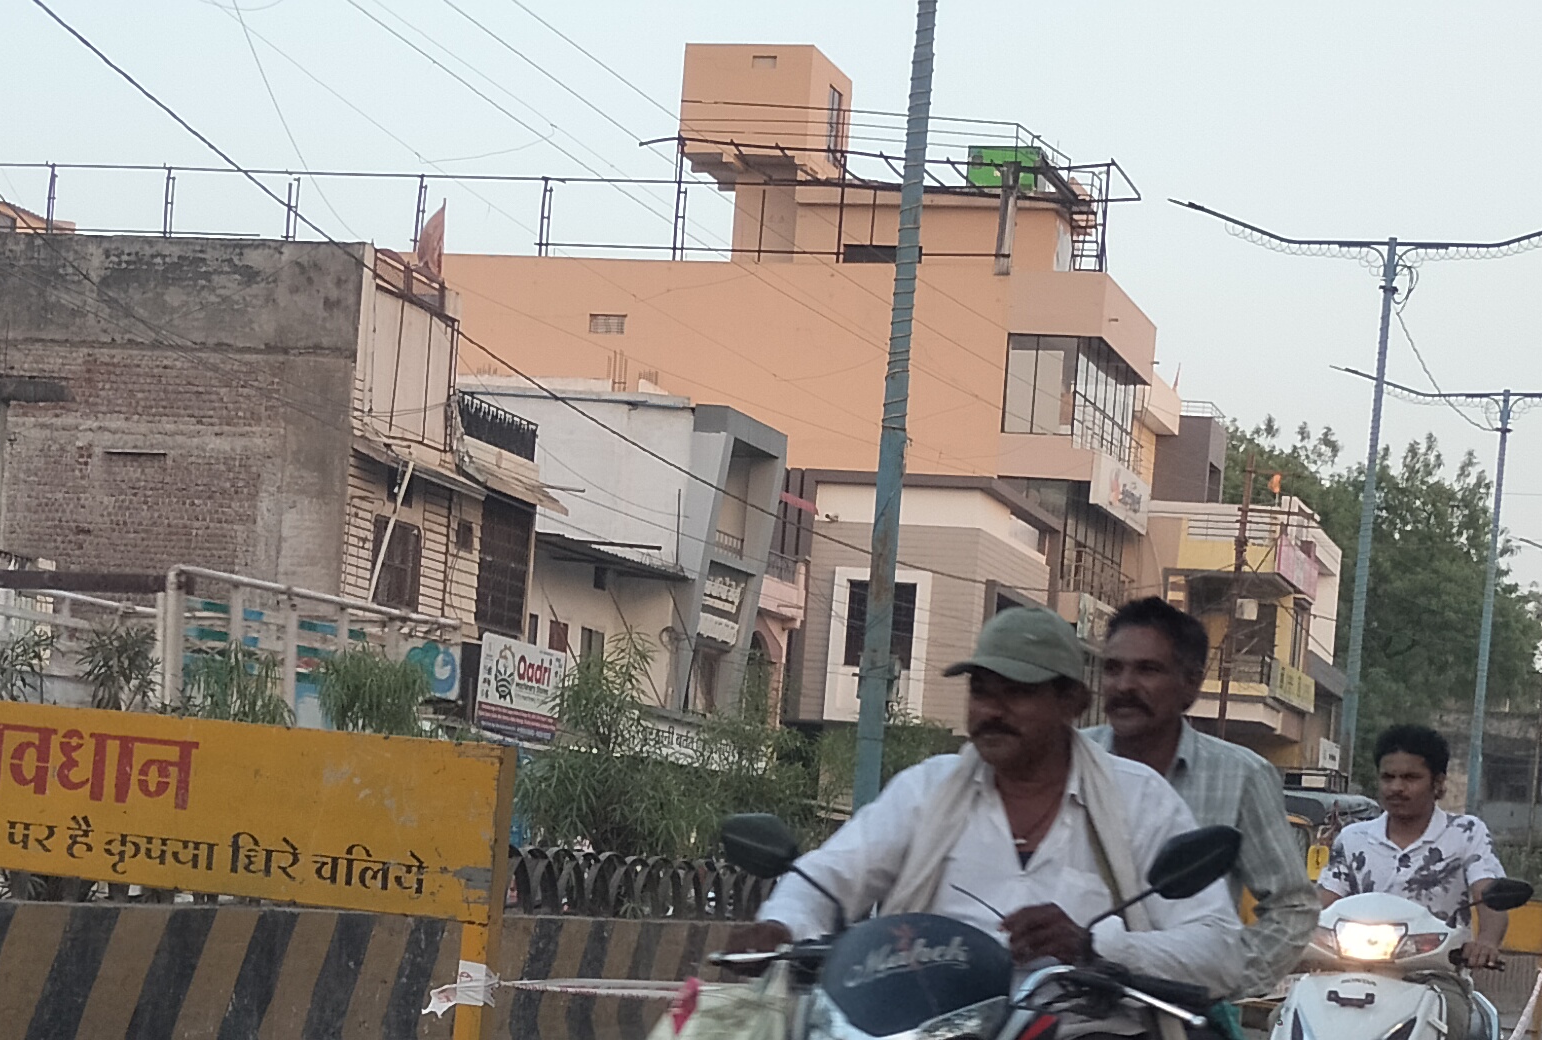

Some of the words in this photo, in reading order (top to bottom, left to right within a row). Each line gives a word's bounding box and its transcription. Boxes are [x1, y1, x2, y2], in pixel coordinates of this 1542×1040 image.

[517, 655, 552, 687] Qadri
[8, 819, 58, 853] पर
[65, 815, 95, 860] है
[104, 831, 218, 875] कृपया
[312, 843, 428, 895] चलिये
